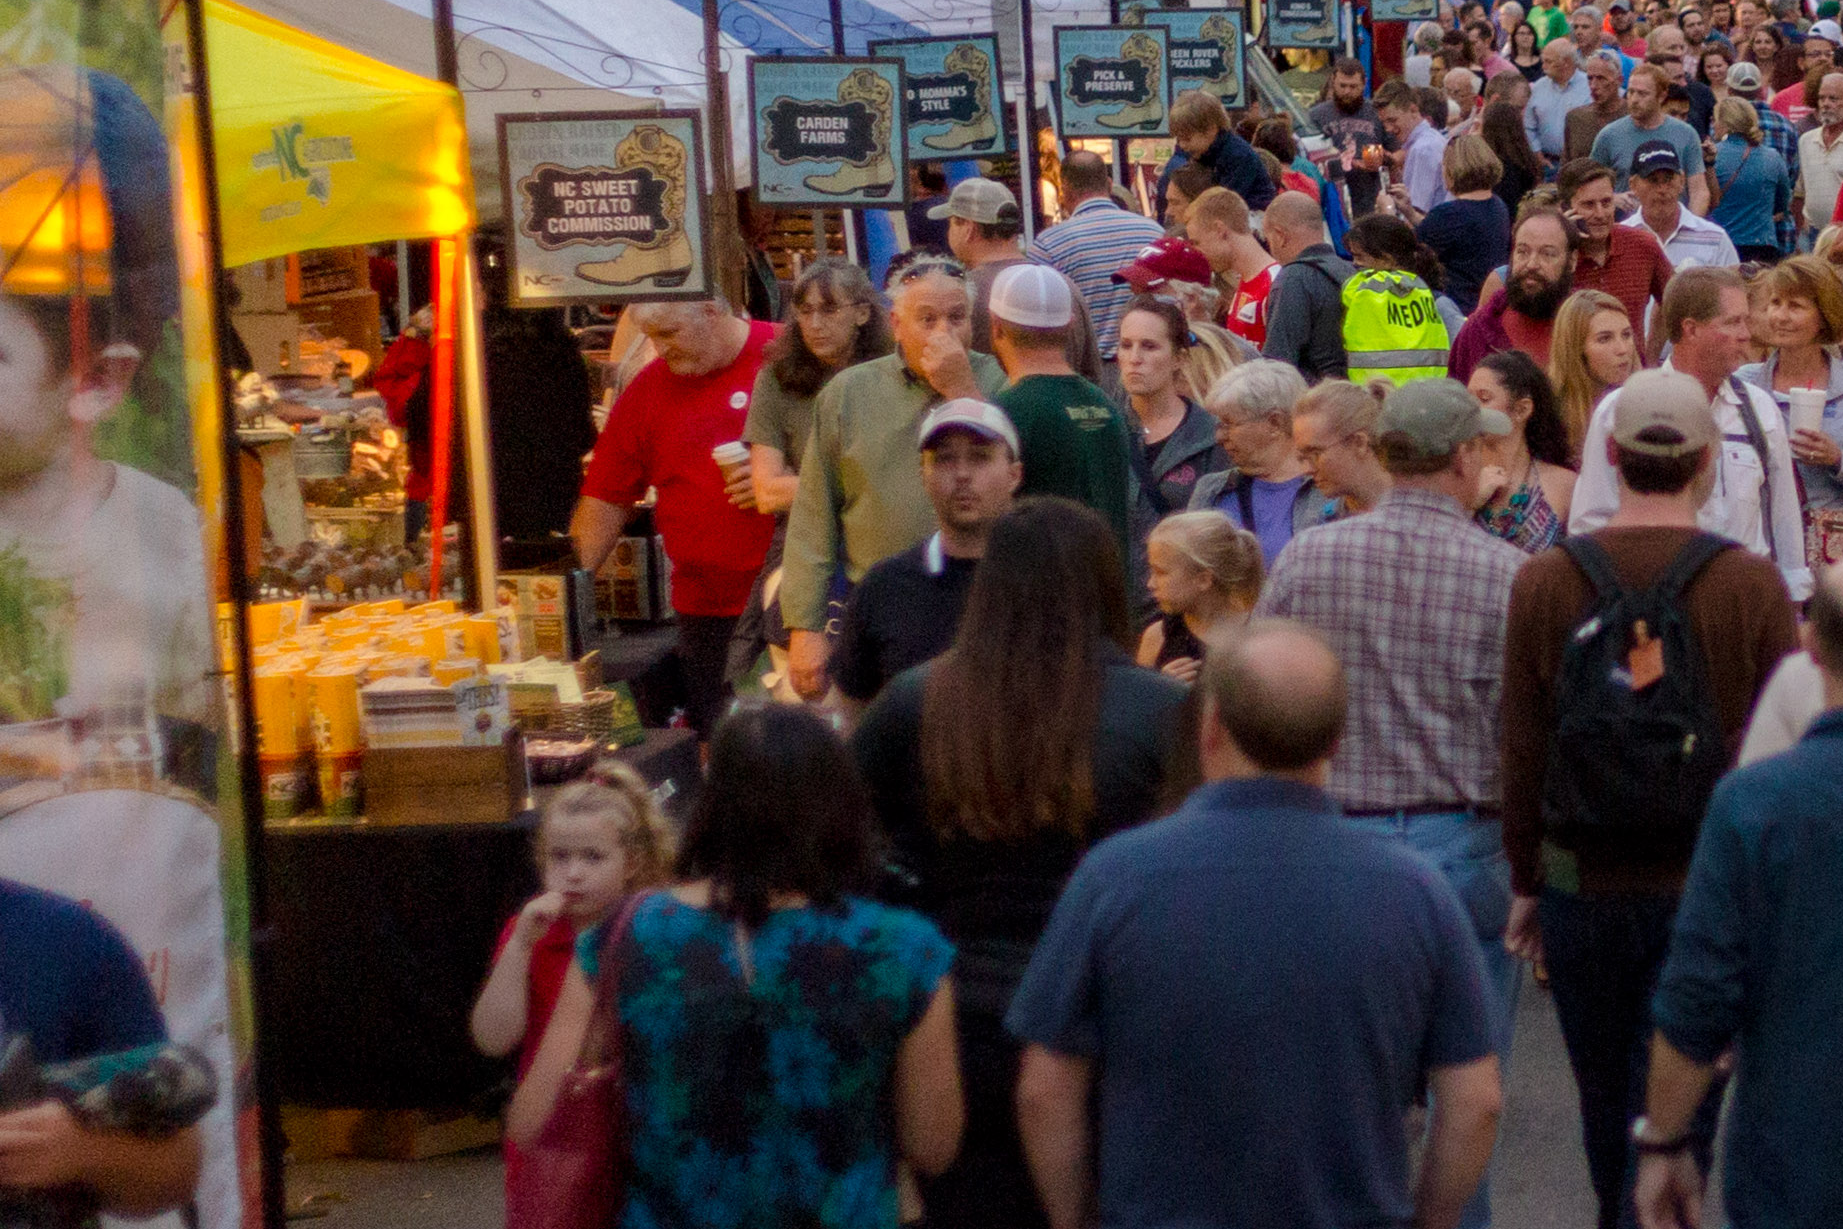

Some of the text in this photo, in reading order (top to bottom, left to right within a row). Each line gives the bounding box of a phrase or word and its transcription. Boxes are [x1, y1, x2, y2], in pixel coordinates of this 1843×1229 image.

[1094, 70, 1116, 80] PICK
[1085, 81, 1135, 92] PRESERVE
[921, 99, 950, 111] STYLE
[797, 116, 849, 130] CARDEN
[800, 131, 846, 144] FARMS
[554, 179, 638, 197] NC SWEET
[564, 198, 632, 214] POTATO
[547, 215, 651, 234] COMMISSION
[1387, 296, 1443, 328] MEDICA
